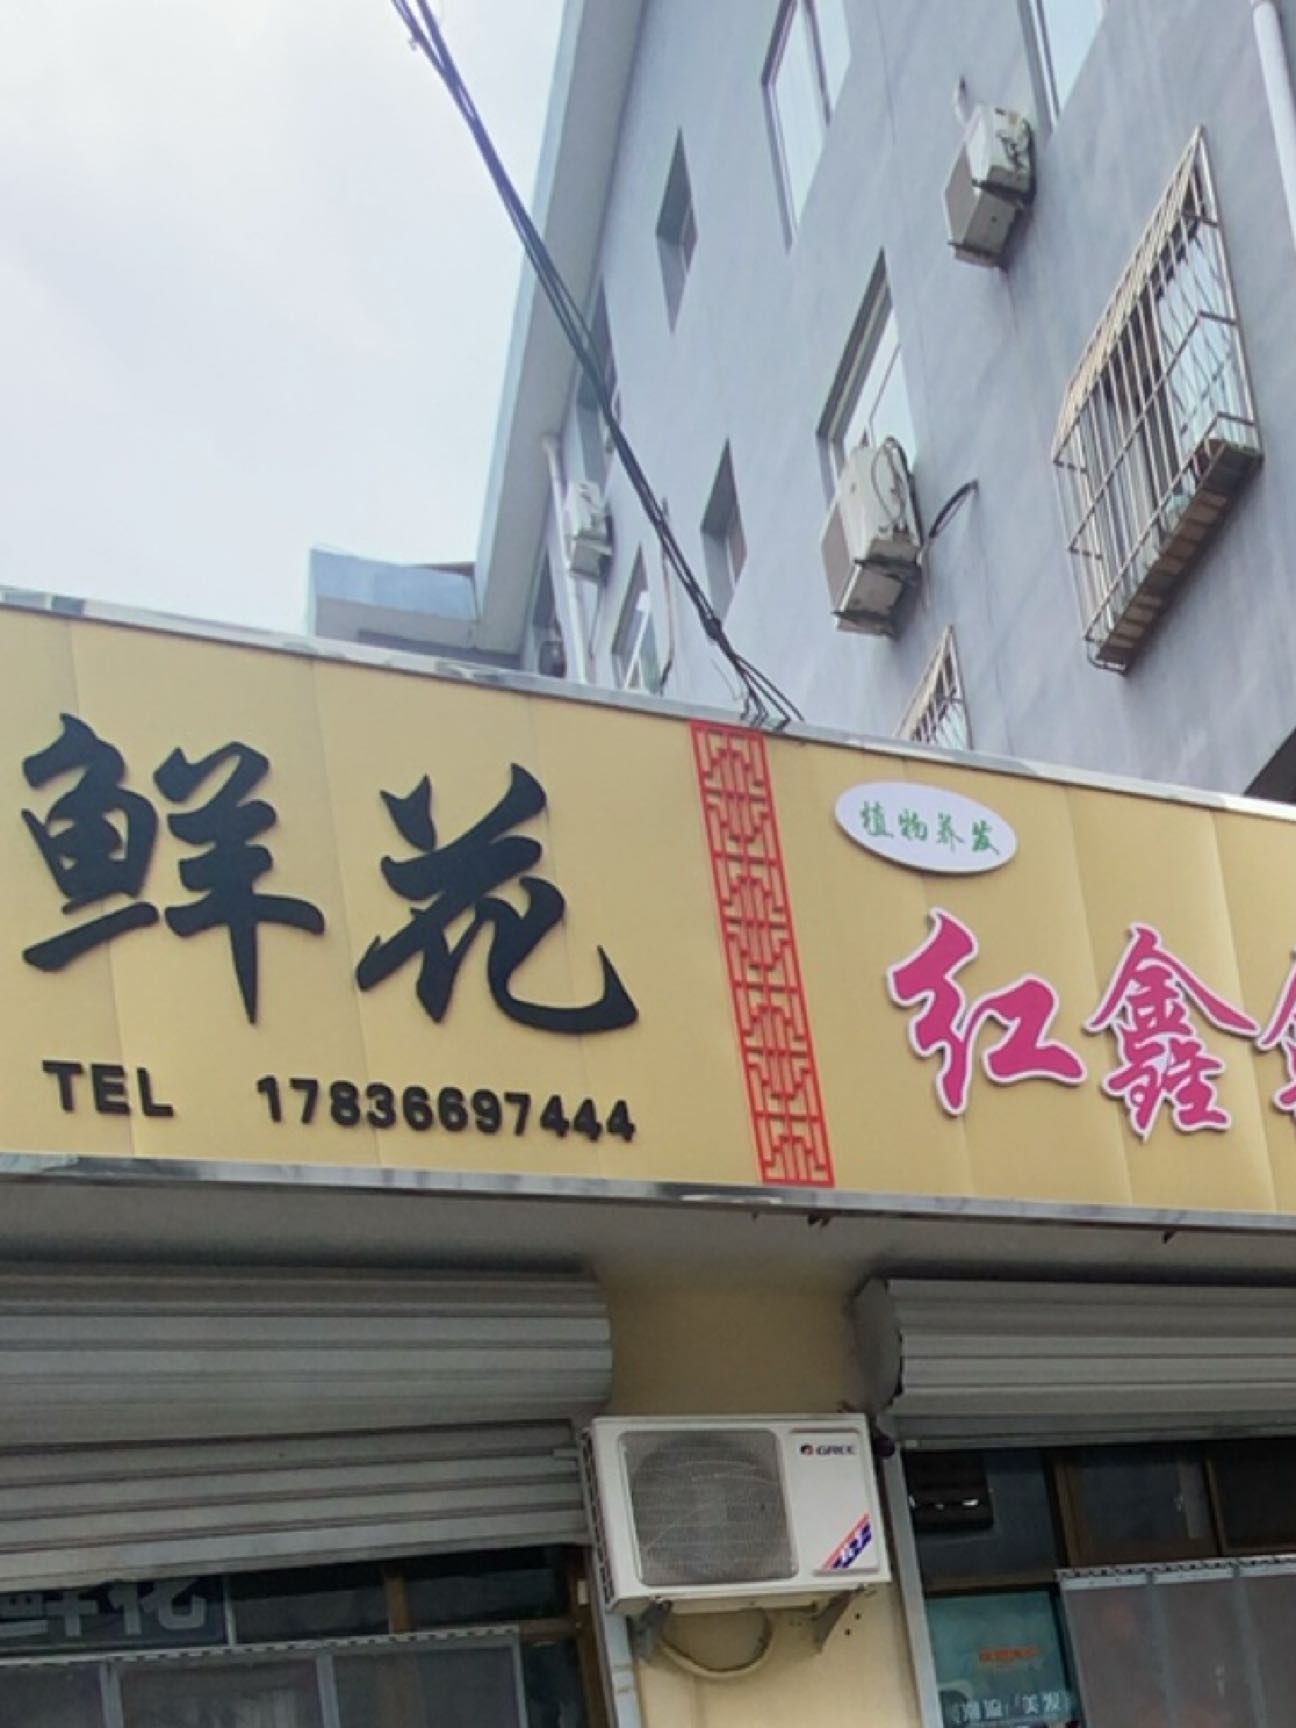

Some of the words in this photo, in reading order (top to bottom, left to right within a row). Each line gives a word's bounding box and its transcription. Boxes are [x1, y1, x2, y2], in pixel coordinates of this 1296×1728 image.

[860, 800, 1001, 856] 植物养发
[22, 713, 639, 1035] 鲜花
[42, 1060, 175, 1118] TEL
[256, 1075, 636, 1143] 17836697444
